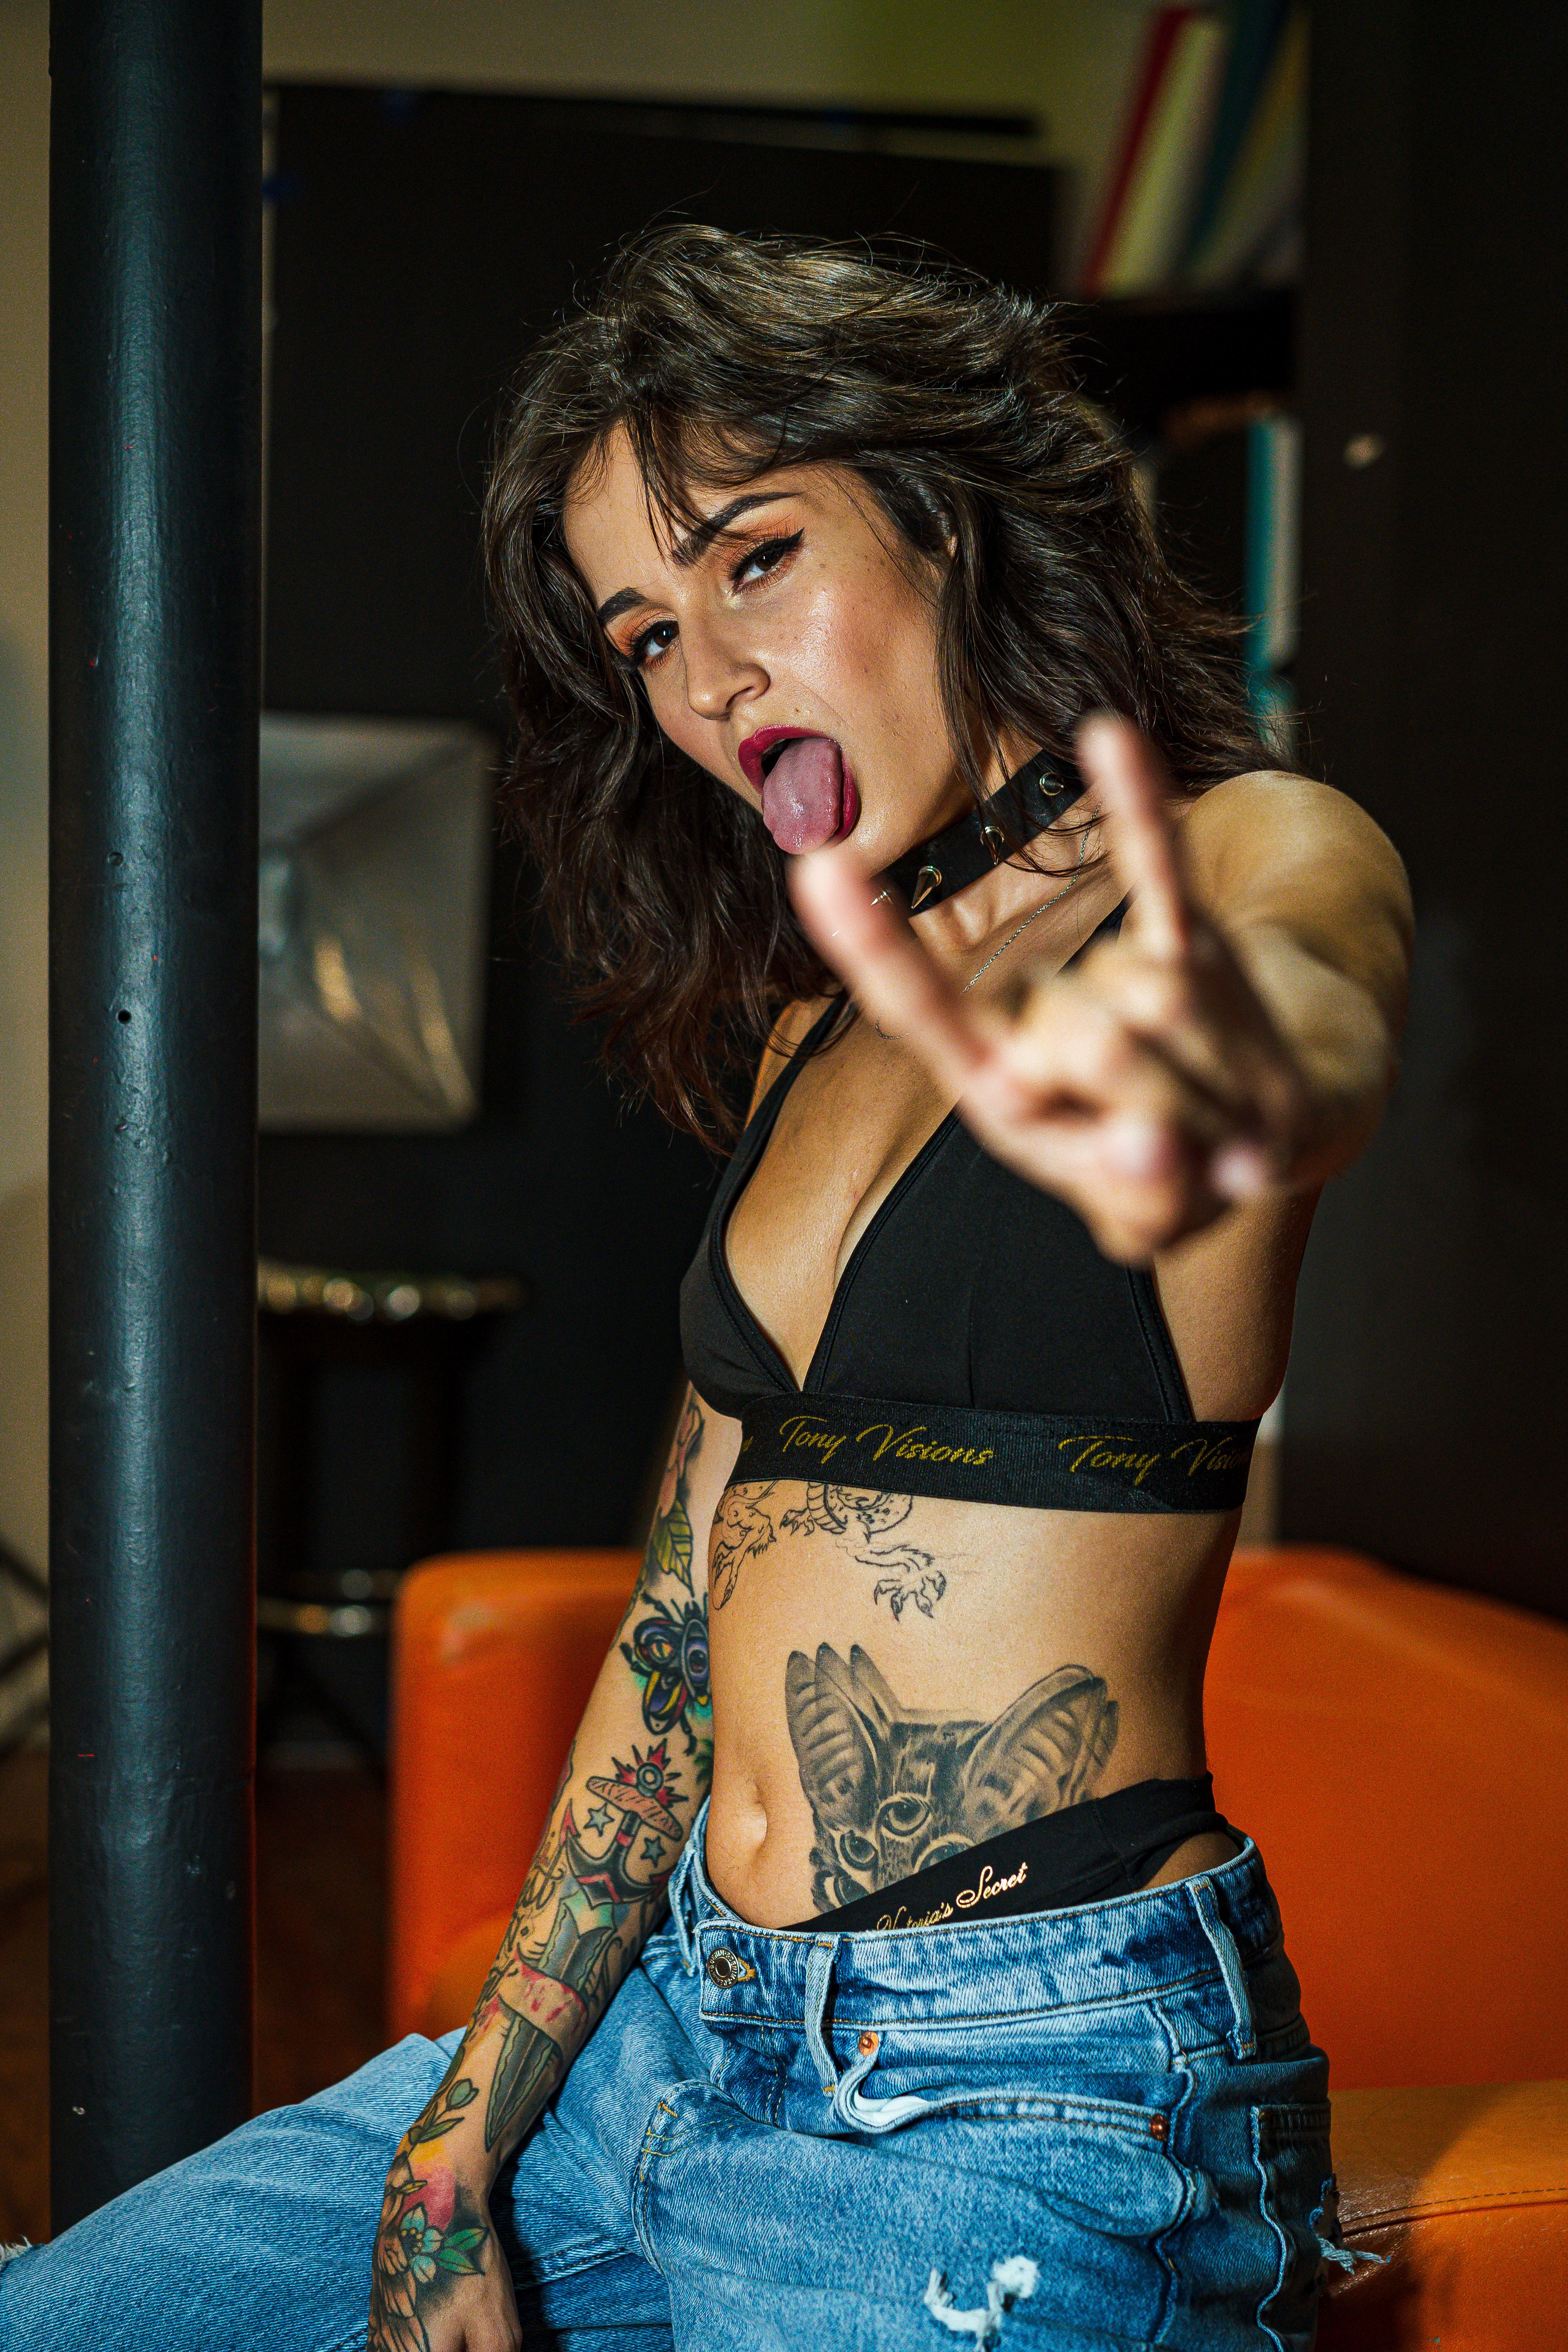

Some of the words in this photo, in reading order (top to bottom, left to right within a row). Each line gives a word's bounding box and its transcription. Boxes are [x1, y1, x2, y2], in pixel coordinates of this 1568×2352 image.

[779, 1416, 847, 1464] Tony
[856, 1424, 995, 1465] Visions
[1058, 1435, 1161, 1486] Tony
[956, 1862, 1028, 1908] Secret
